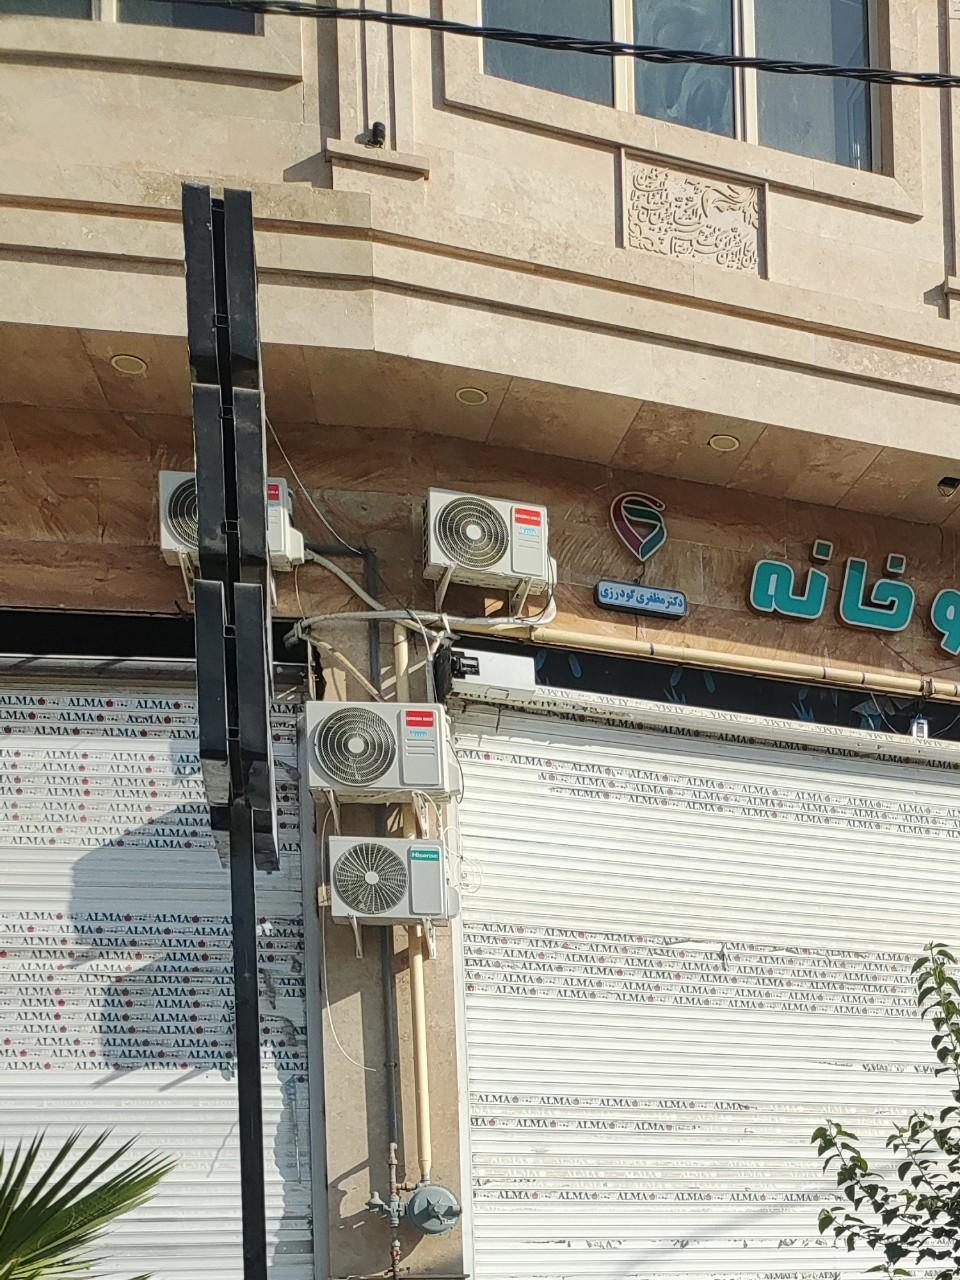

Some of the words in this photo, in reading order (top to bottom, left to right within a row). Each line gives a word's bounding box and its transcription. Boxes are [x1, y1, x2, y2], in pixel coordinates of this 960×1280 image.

[600, 586, 635, 602] گودرزی
[635, 591, 665, 606] مظفری
[665, 595, 683, 609] دکتر
[68, 698, 104, 708] ALMA
[135, 700, 171, 710] ALMA
[58, 712, 98, 722] ALMA
[126, 714, 162, 724] ALMA
[34, 726, 69, 736] ALMA
[102, 727, 138, 738] ALMA
[604, 717, 636, 730] ALMA
[661, 725, 692, 737] ALMA
[718, 732, 748, 744] ALMA
[771, 740, 800, 751] ALMA
[825, 746, 852, 757] ALMA
[875, 753, 904, 764] ALMA
[926, 759, 952, 769] ALMA
[510, 754, 543, 767] ALMA
[570, 763, 602, 775] ALMA
[630, 770, 660, 782] ALMA
[686, 776, 716, 789] ALMA
[574, 776, 606, 788] ALMA
[634, 782, 664, 795] ALMA
[746, 797, 775, 808] ALMA
[800, 803, 828, 814] ALMA
[174, 804, 209, 814] ALMA
[569, 788, 600, 799] ALMA
[628, 794, 659, 806] ALMA
[686, 801, 715, 812] ALMA
[741, 808, 769, 818] ALMA
[794, 813, 822, 824] ALMA
[846, 820, 873, 830] ALMA
[896, 825, 923, 835] ALMA
[175, 816, 212, 826] ALMA
[153, 828, 188, 838] ALMA
[78, 838, 115, 847] ALMA
[147, 840, 184, 849] ALMA
[85, 912, 122, 922] ALMA
[154, 914, 190, 924] ALMA
[57, 924, 94, 934] ALMA
[125, 926, 161, 936] ALMA
[193, 927, 229, 937] ALMA
[482, 923, 514, 934] ALMA
[544, 928, 576, 938] ALMA
[603, 933, 634, 942] ALMA
[22, 937, 58, 946] ALMA
[91, 938, 127, 947] ALMA
[160, 939, 196, 948] ALMA
[464, 934, 498, 945] ALMA
[588, 944, 619, 954] ALMA
[31, 950, 66, 960] ALMA
[98, 951, 133, 960] ALMA
[164, 952, 200, 962] ALMA
[503, 949, 536, 960] ALMA
[564, 954, 596, 964] ALMA
[624, 958, 655, 968] ALMA
[156, 965, 192, 974] ALMA
[9, 973, 44, 982] ALMA
[77, 974, 113, 983] ALMA
[145, 975, 181, 984] ALMA
[521, 962, 554, 972] ALMA
[582, 966, 614, 976] ALMA
[641, 970, 672, 980] ALMA
[755, 978, 784, 987] ALMA
[808, 982, 837, 990] ALMA
[861, 984, 889, 993] ALMA
[16, 987, 52, 996] ALMA
[84, 987, 120, 996] ALMA
[152, 987, 187, 997] ALMA
[502, 974, 534, 984] ALMA
[562, 978, 594, 987] ALMA
[621, 982, 652, 991] ALMA
[679, 986, 708, 995] ALMA
[788, 992, 816, 1001] ALMA
[20, 998, 56, 1008] ALMA
[88, 999, 124, 1008] ALMA
[156, 999, 192, 1009] ALMA
[494, 986, 527, 996] ALMA
[556, 990, 588, 999] ALMA
[615, 993, 646, 1002] ALMA
[672, 996, 702, 1006] ALMA
[728, 1000, 757, 1009] ALMA
[833, 1006, 862, 1015] ALMA
[16, 1012, 52, 1021] ALMA
[84, 1012, 120, 1022] ALMA
[152, 1012, 188, 1022] ALMA
[22, 1024, 58, 1034] ALMA
[90, 1024, 126, 1034] ALMA
[158, 1025, 194, 1035] ALMA
[34, 1037, 70, 1046] ALMA
[103, 1038, 140, 1047] ALMA
[172, 1038, 209, 1048] ALMA
[51, 1049, 86, 1058] ALMA
[119, 1049, 156, 1059] ALMA
[188, 1050, 224, 1059] ALMA
[74, 1061, 110, 1070] ALMA
[143, 1061, 179, 1070] ALMA
[477, 1095, 510, 1104] ALMA
[540, 1097, 570, 1106] ALMA
[600, 1099, 631, 1107] ALMA
[657, 1100, 688, 1108] ALMA
[712, 1102, 742, 1110] ALMA
[516, 1118, 548, 1128] ALMA
[576, 1120, 606, 1129] ALMA
[634, 1122, 665, 1130] ALMA
[498, 1190, 530, 1200] ALMA
[558, 1191, 589, 1200] ALMA
[617, 1192, 648, 1200] ALMA
[674, 1192, 704, 1200] ALMA
[729, 1193, 758, 1201] ALMA
